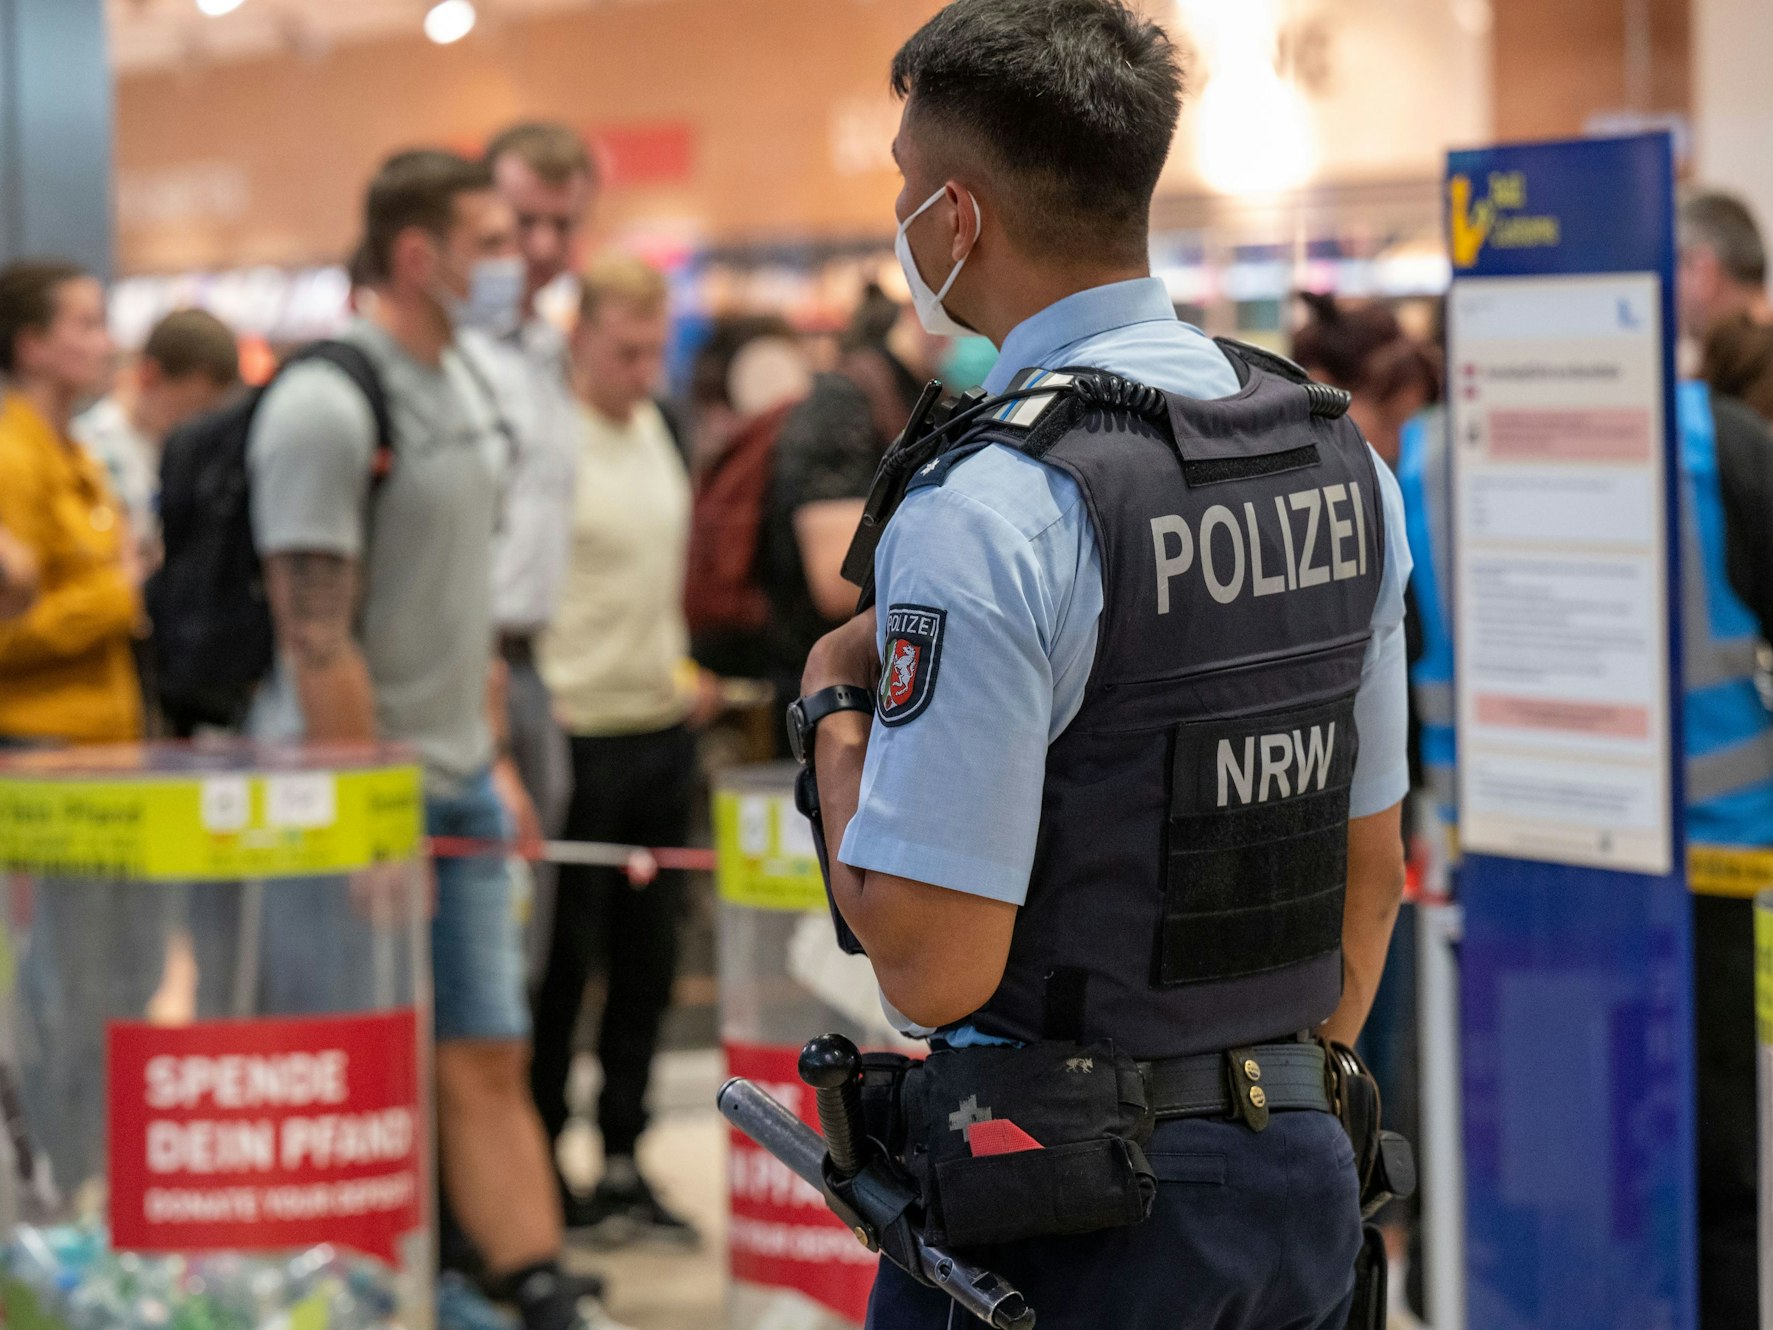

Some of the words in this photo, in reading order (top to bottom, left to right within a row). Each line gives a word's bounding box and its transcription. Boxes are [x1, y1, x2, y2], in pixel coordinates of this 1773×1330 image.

[1150, 482, 1367, 615] POLIZEI
[887, 614, 936, 637] POLIZEI
[1216, 721, 1336, 807] NRW
[146, 1050, 347, 1108] SPENDE
[147, 1119, 274, 1172] DEIN
[280, 1107, 412, 1171] PFAND
[144, 1185, 257, 1224] DONATE
